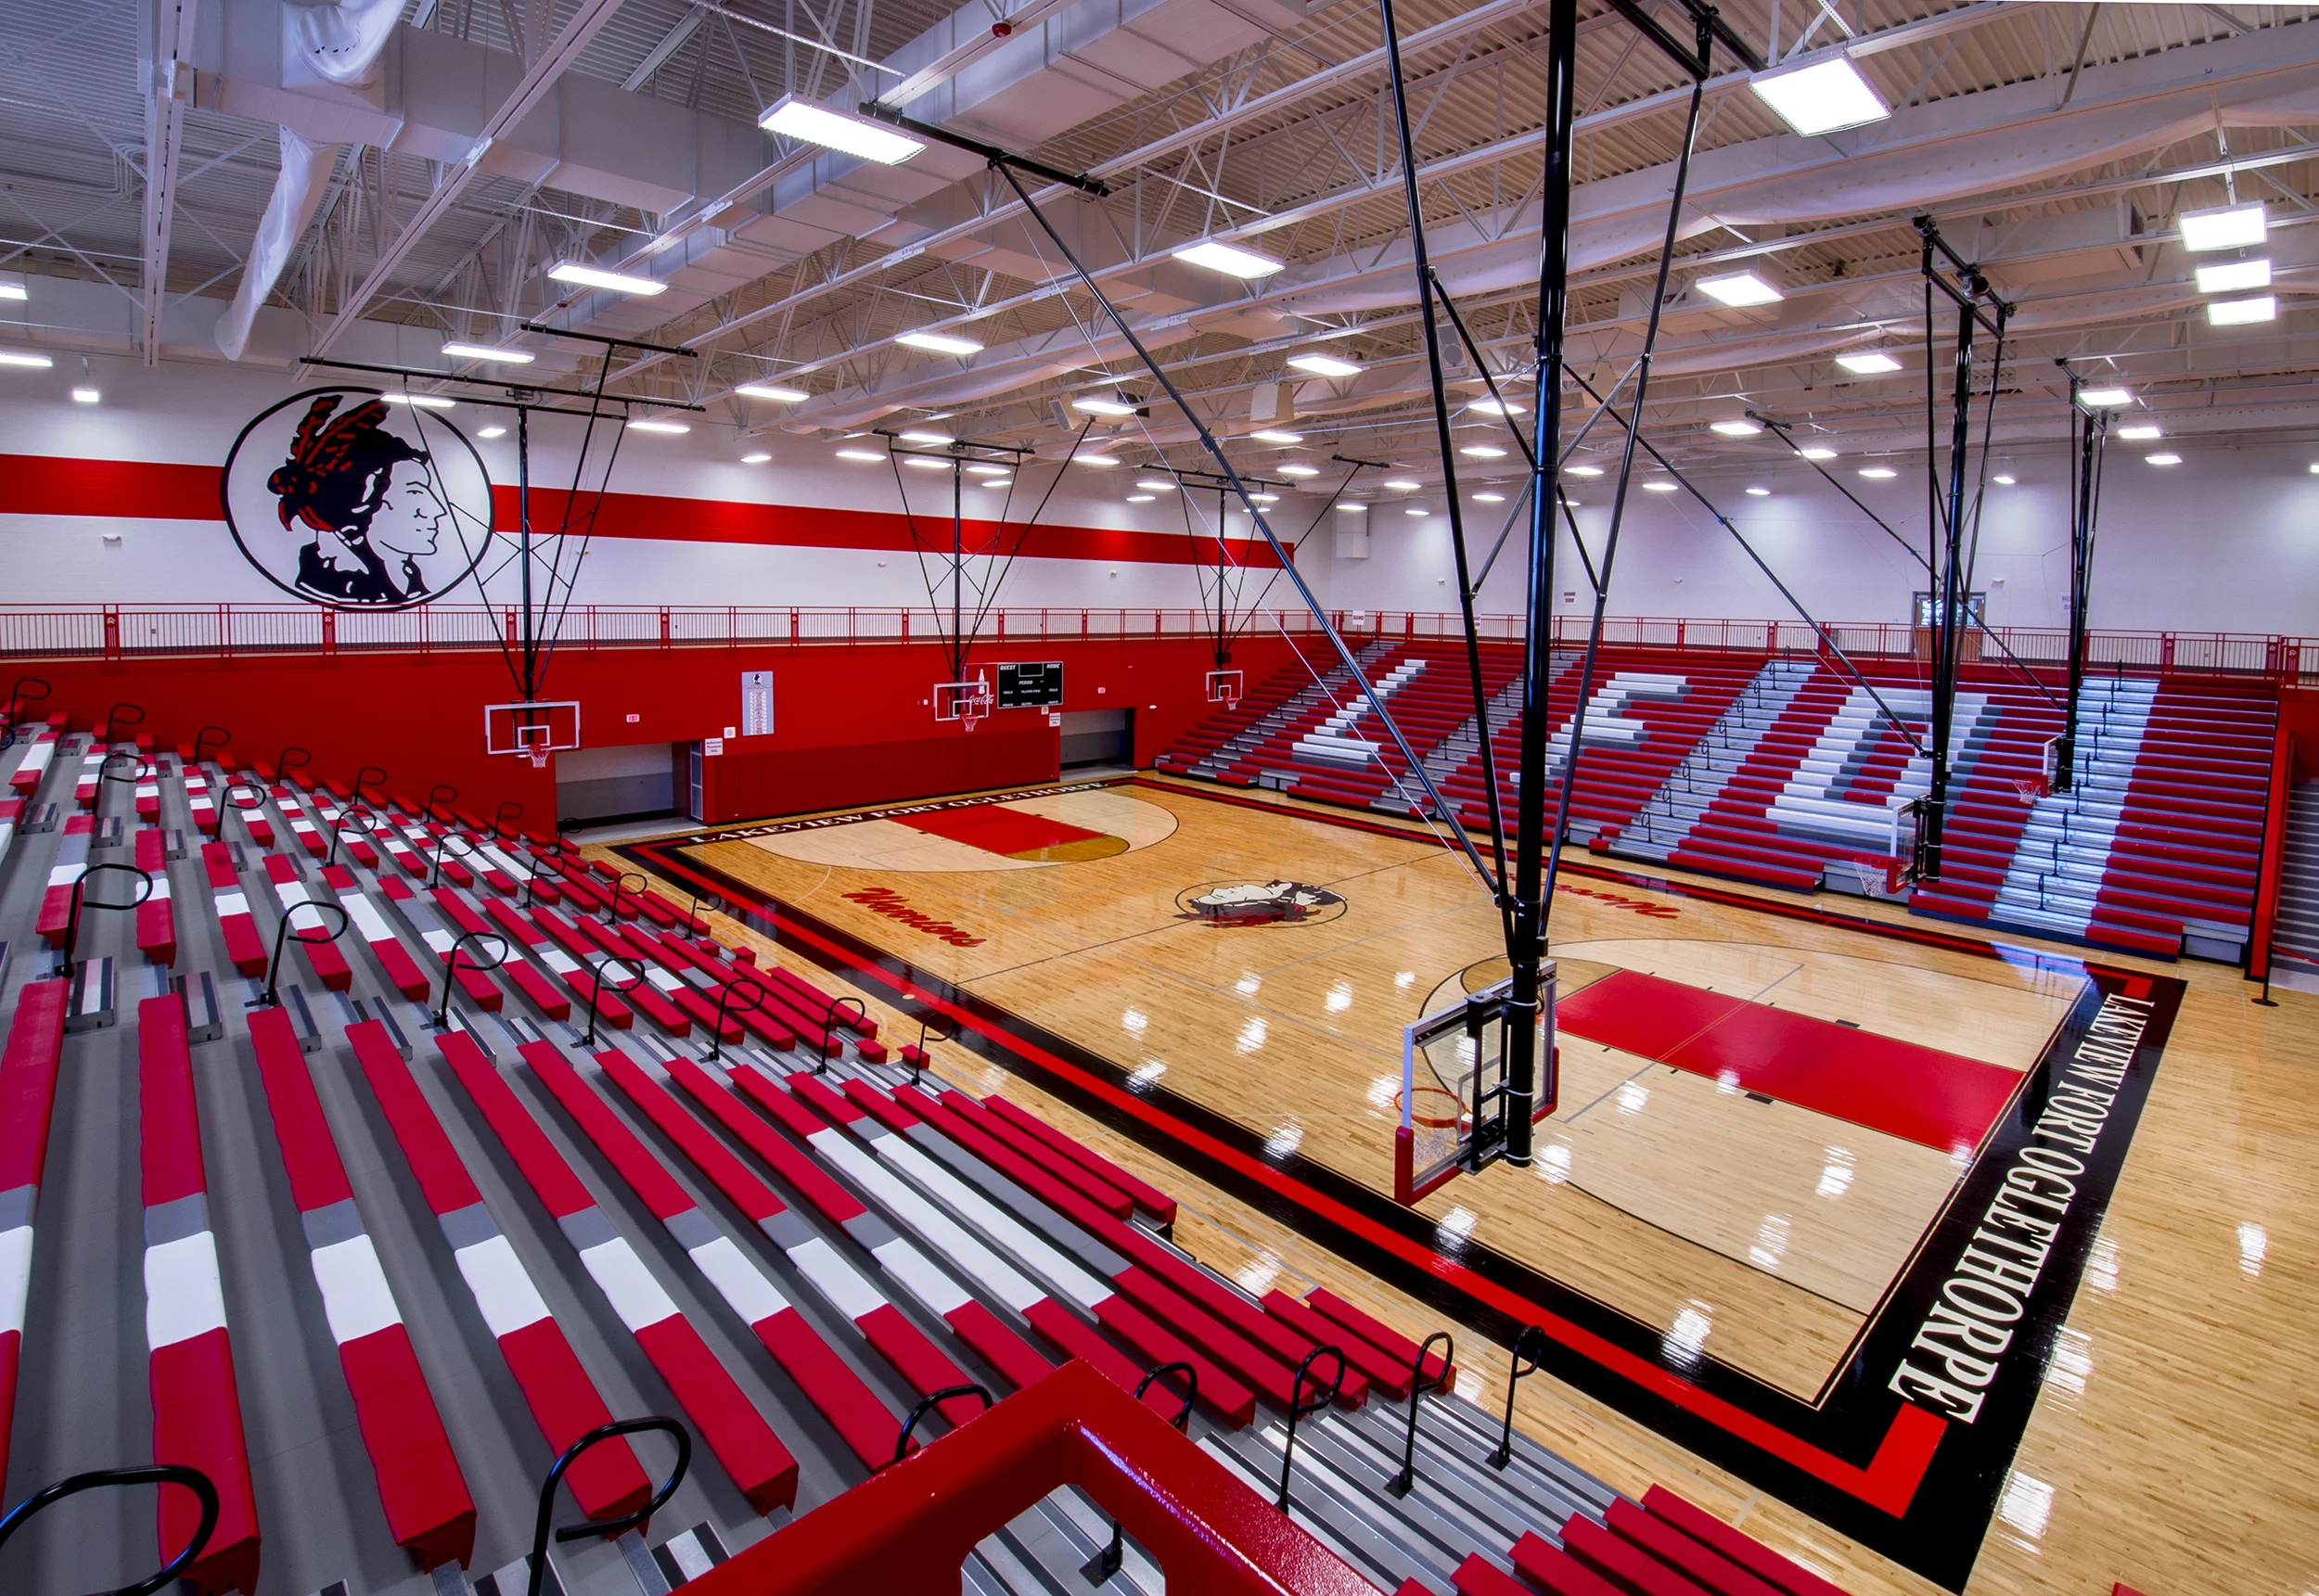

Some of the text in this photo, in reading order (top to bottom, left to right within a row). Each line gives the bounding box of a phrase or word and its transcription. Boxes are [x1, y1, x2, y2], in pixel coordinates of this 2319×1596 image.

[690, 782, 1108, 844] LAKEVIEW FORT OGLETHORPE
[840, 887, 987, 948] Warriors
[1887, 992, 2156, 1424] LAKEVIEW FORT OGLETHORPE
